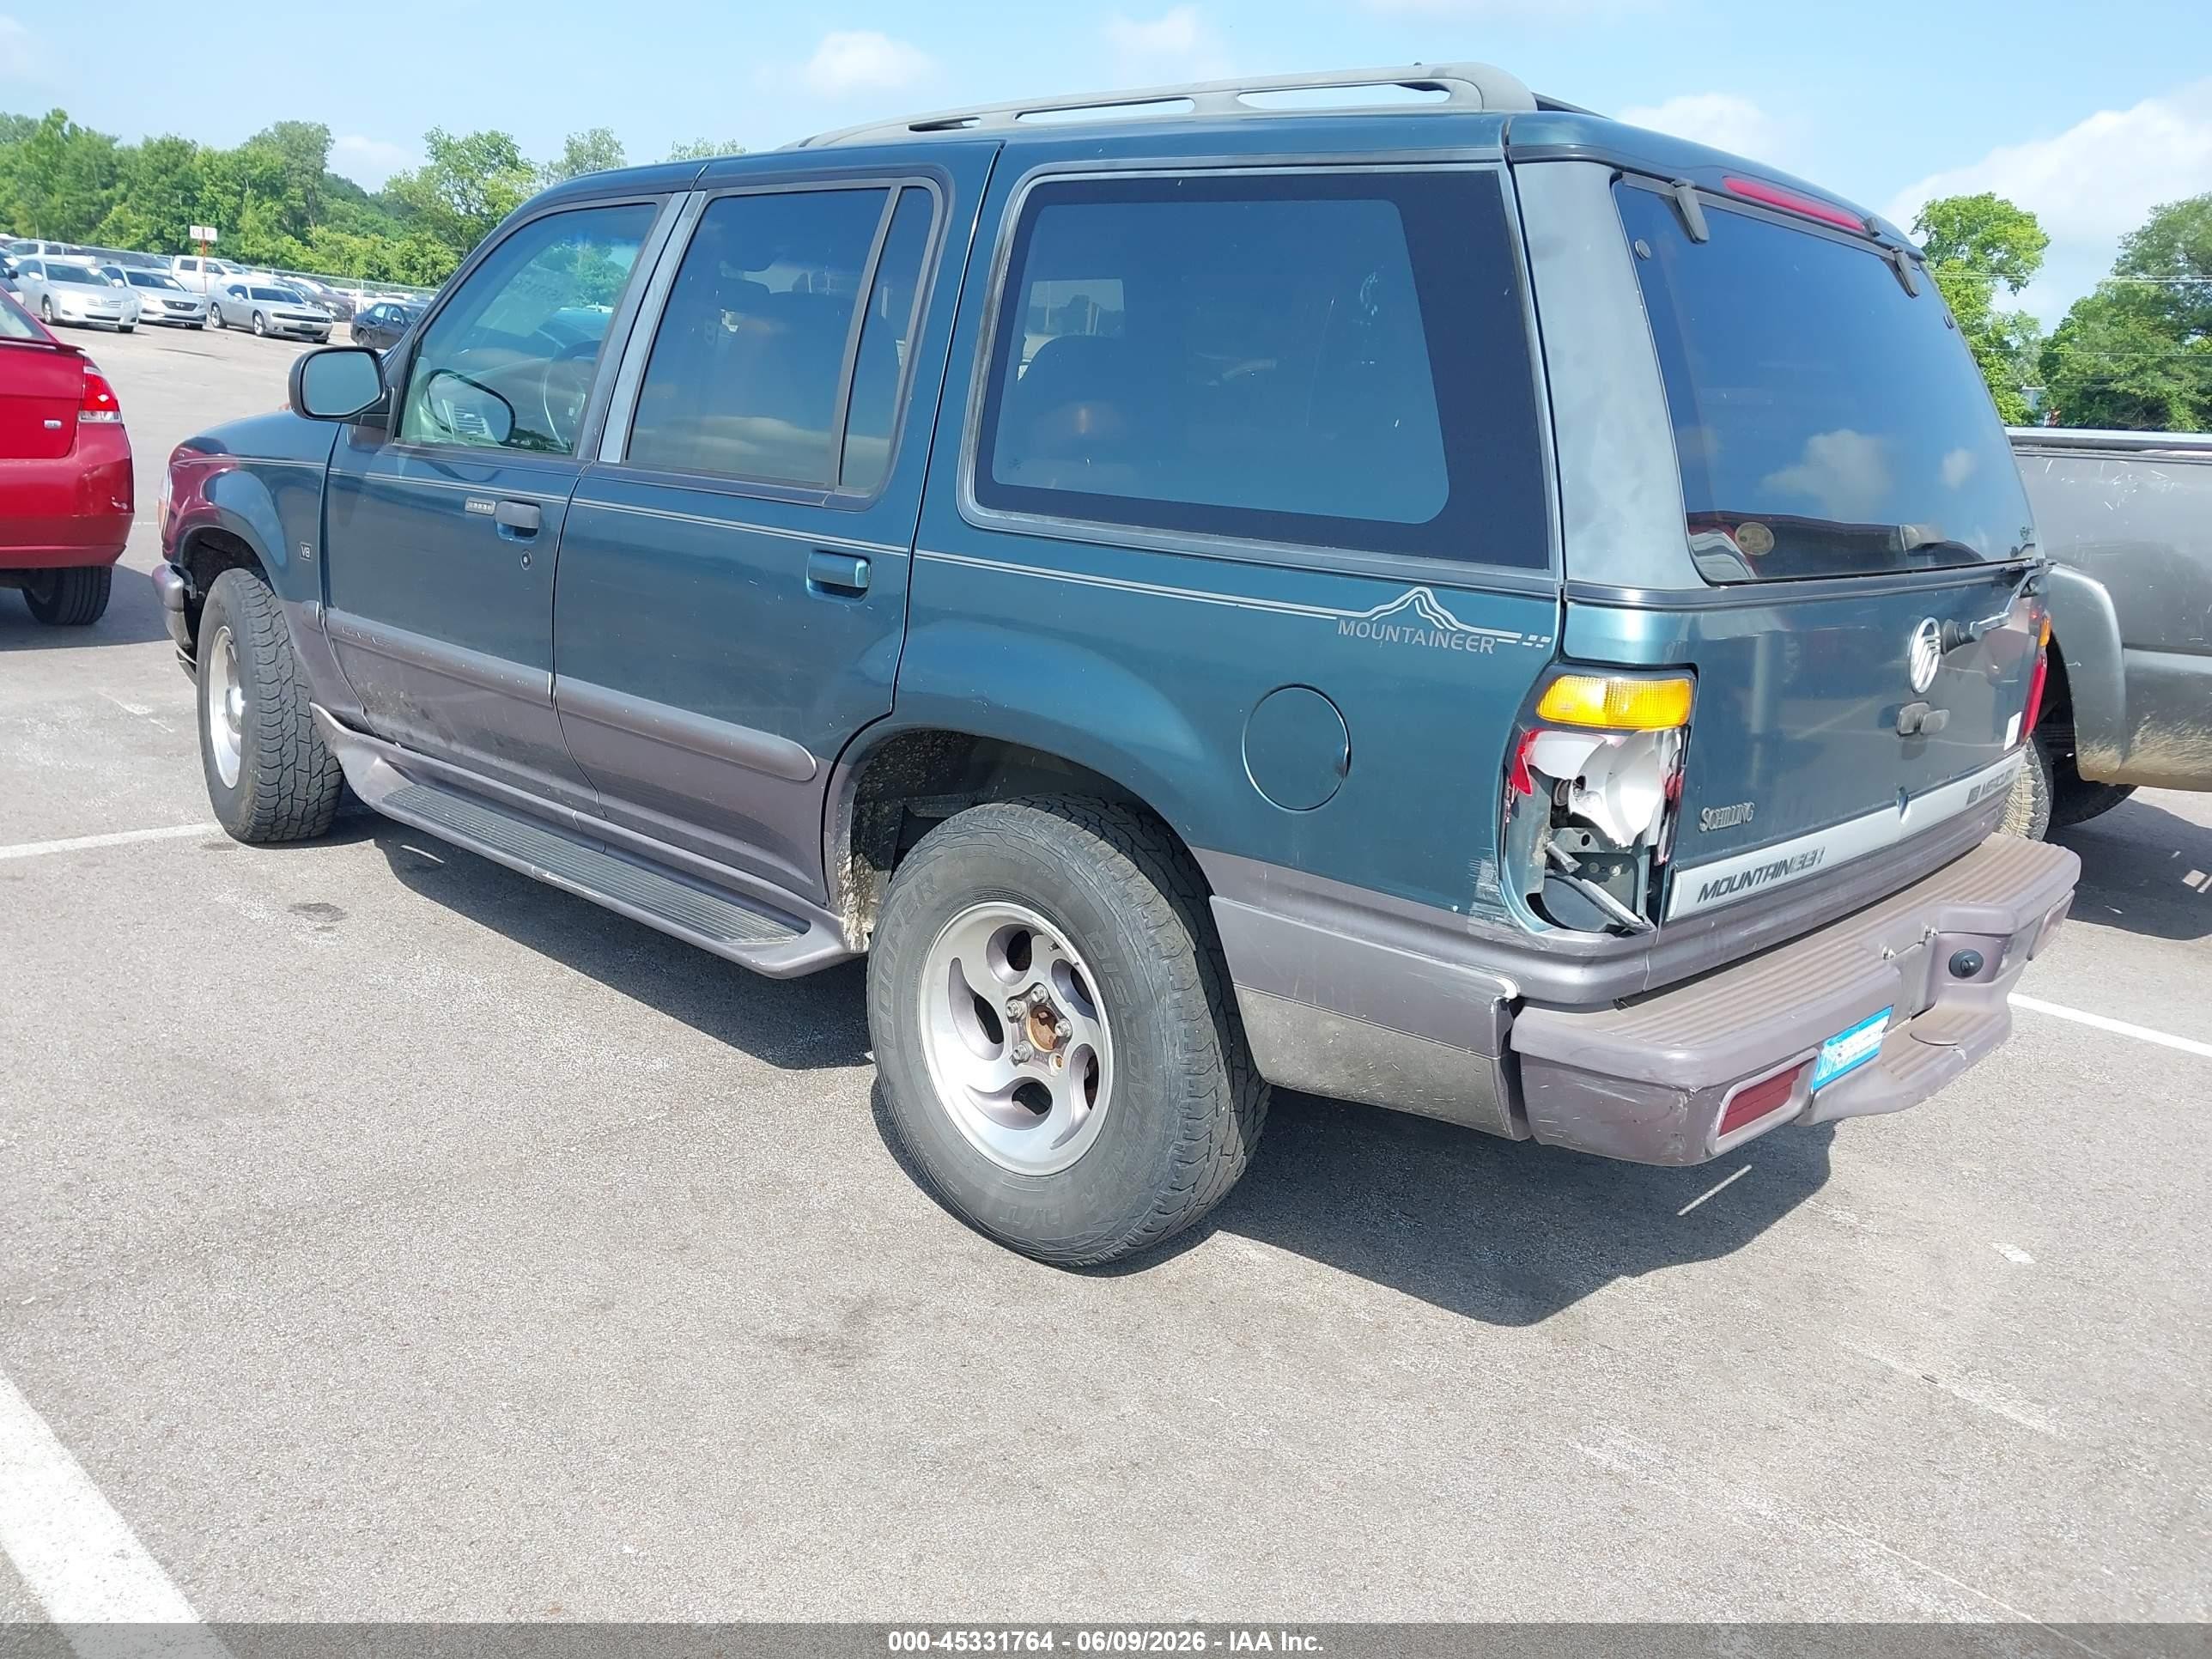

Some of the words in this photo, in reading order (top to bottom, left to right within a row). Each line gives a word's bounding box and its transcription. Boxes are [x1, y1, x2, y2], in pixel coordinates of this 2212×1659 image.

[301, 545, 310, 558] V8
[1337, 619, 1496, 654] MOUNTAINEER
[1698, 801, 1755, 832] SCHILLING
